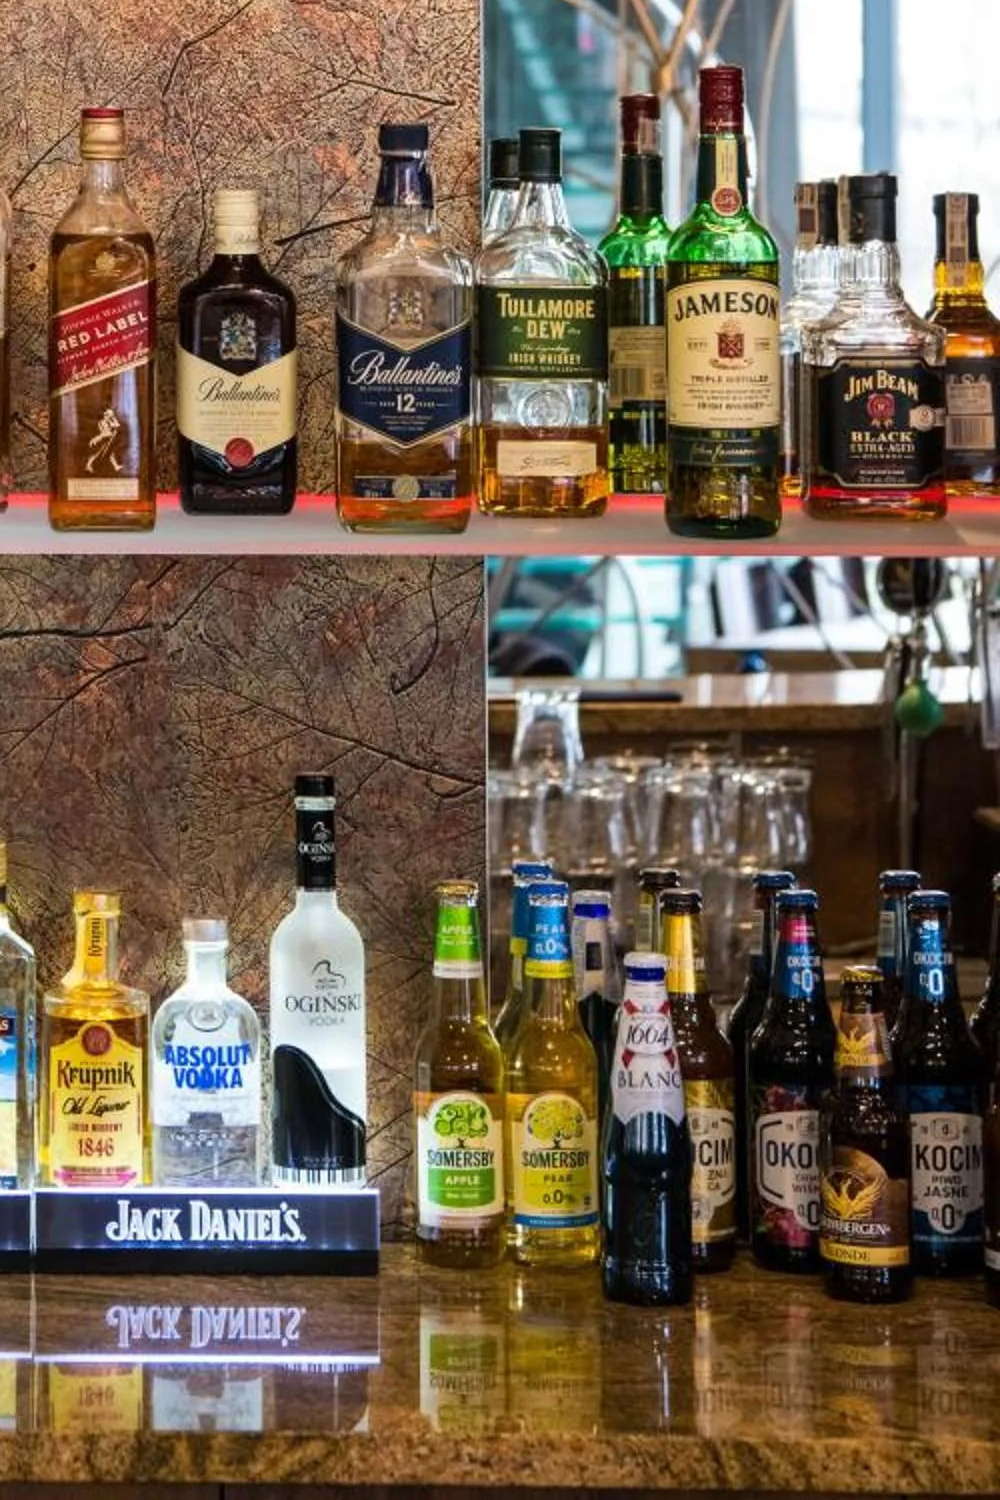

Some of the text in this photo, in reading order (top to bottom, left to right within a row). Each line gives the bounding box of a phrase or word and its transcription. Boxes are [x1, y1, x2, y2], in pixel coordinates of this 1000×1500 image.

[496, 293, 596, 319] TULLAMORE
[675, 291, 778, 322] JAMESON
[57, 311, 149, 353] RED LABEL
[347, 349, 464, 385] Ballantine's
[539, 353, 582, 365] WHISKEY
[199, 375, 281, 403] Ballantine's
[844, 369, 919, 401] JIM BEAM
[396, 394, 417, 413] 12
[850, 431, 914, 443] BLACK
[626, 1022, 672, 1046] 1664
[165, 1044, 250, 1065] ABSOLUT
[57, 1060, 136, 1092] Krupnik
[174, 1067, 244, 1089] VODKA
[617, 1068, 682, 1089] BLANC
[61, 1096, 86, 1114] Old
[78, 1137, 114, 1158] 1846
[699, 1138, 734, 1166] CIM
[766, 1141, 812, 1167] OKO
[427, 1149, 495, 1168] SOMERSBY
[522, 1150, 590, 1169] SOMERSBY
[445, 1176, 480, 1186] APPLE
[543, 1174, 573, 1183] PEAR
[923, 1185, 969, 1198] JASNE
[105, 1199, 307, 1243] JACK DANIEL'S
